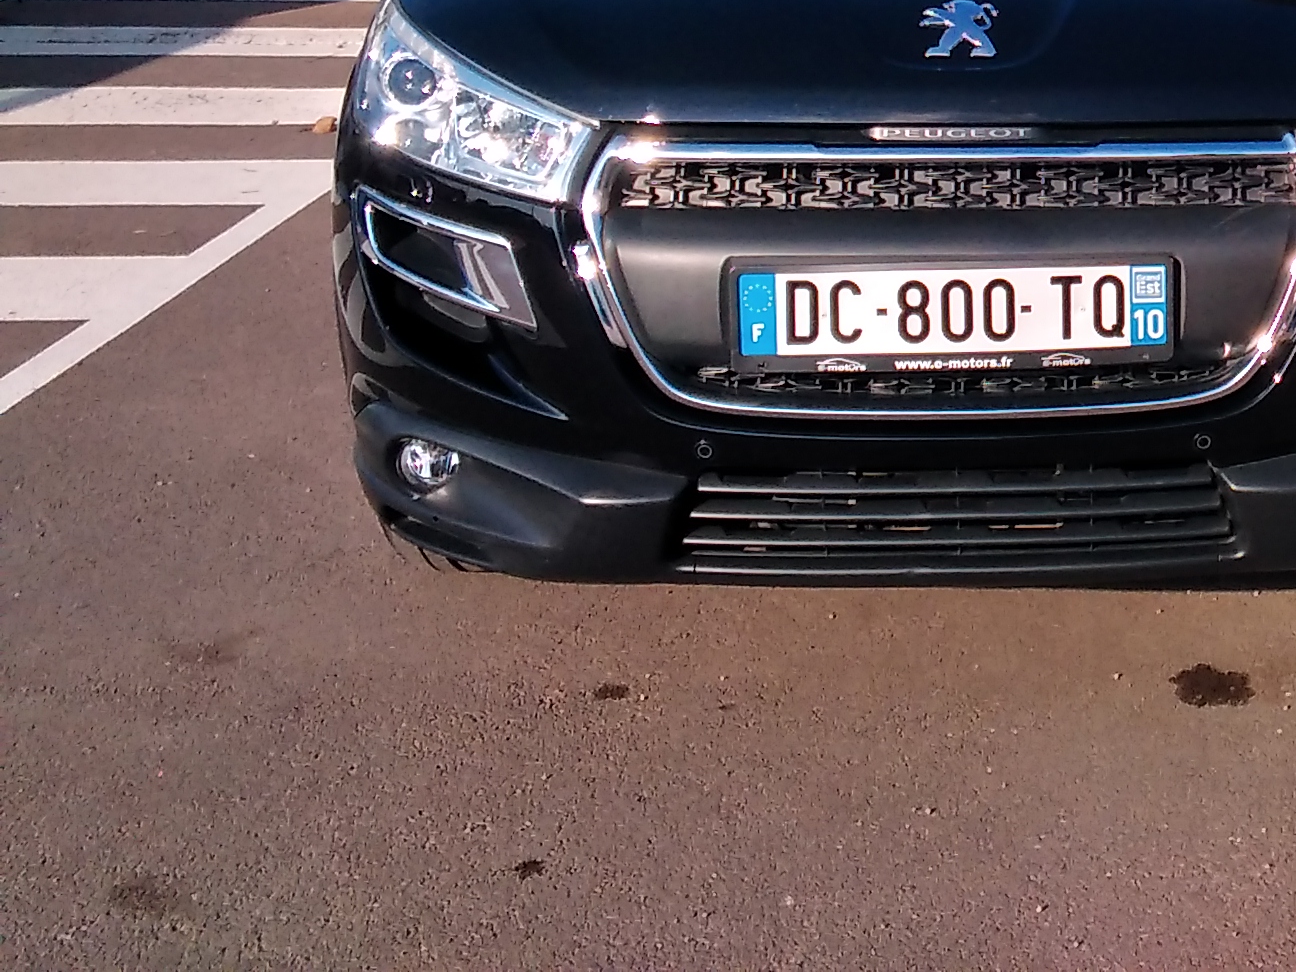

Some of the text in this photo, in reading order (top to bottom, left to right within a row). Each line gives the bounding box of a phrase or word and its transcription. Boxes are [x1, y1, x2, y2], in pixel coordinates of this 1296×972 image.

[882, 127, 1032, 139] PEUGEOT
[1134, 308, 1164, 340] 10
[751, 323, 765, 343] F
[894, 356, 1014, 370] www.e-motors.fr
